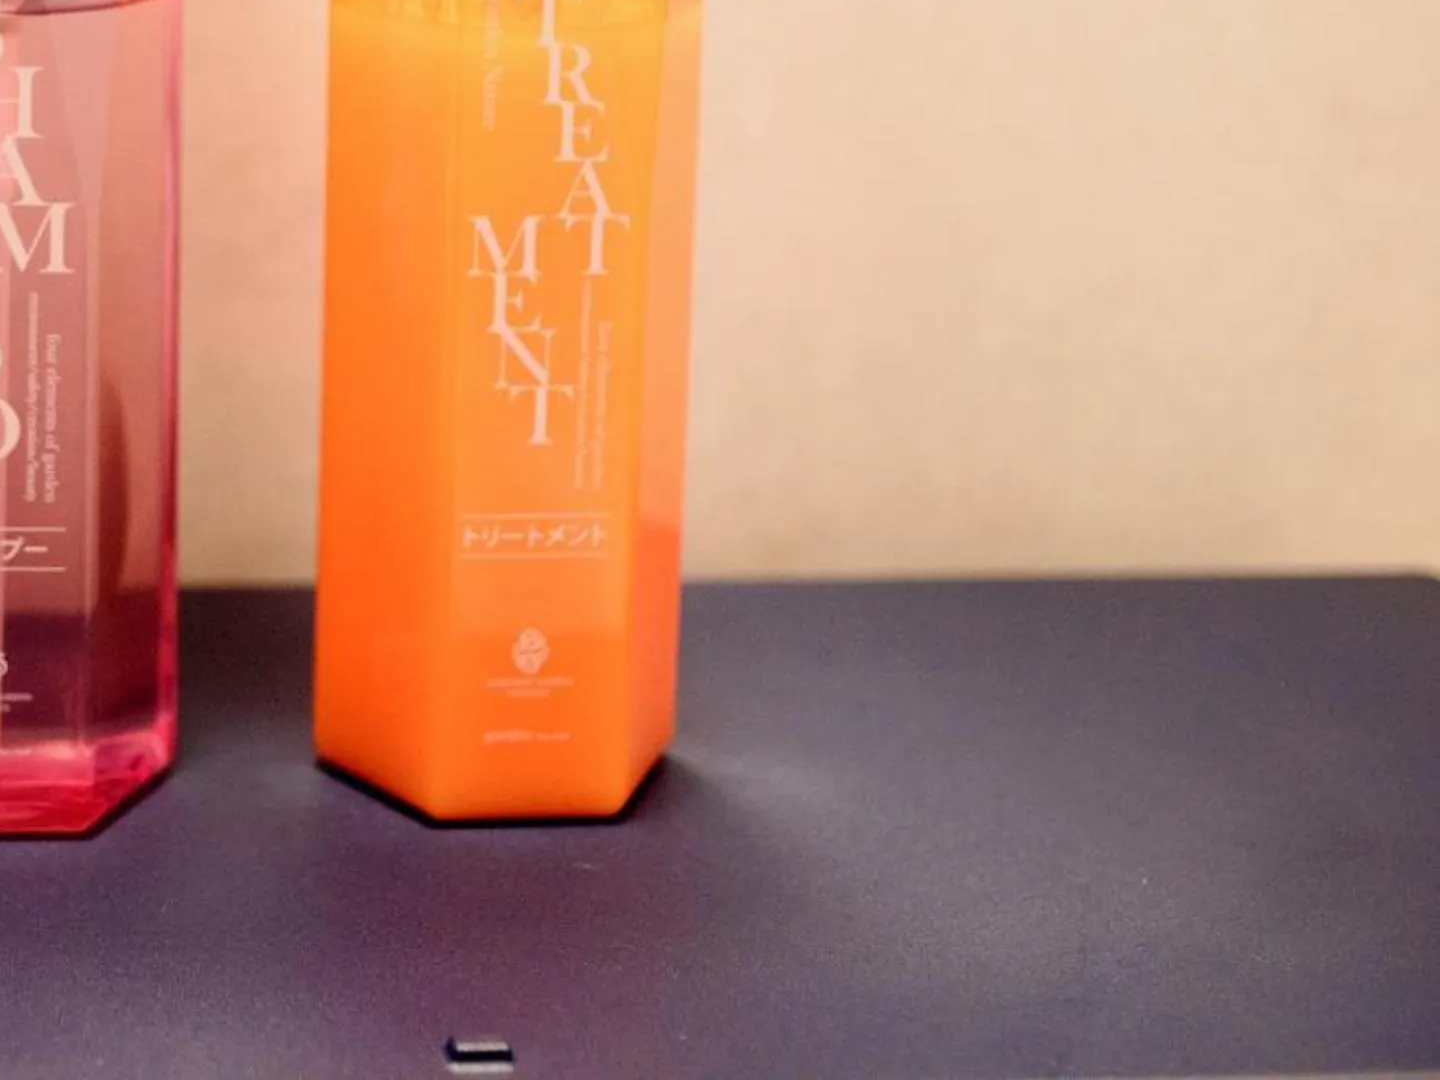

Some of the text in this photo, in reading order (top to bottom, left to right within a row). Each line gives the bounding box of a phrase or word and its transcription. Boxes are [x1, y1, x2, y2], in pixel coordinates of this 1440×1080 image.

[462, 523, 607, 551] トリートメント
